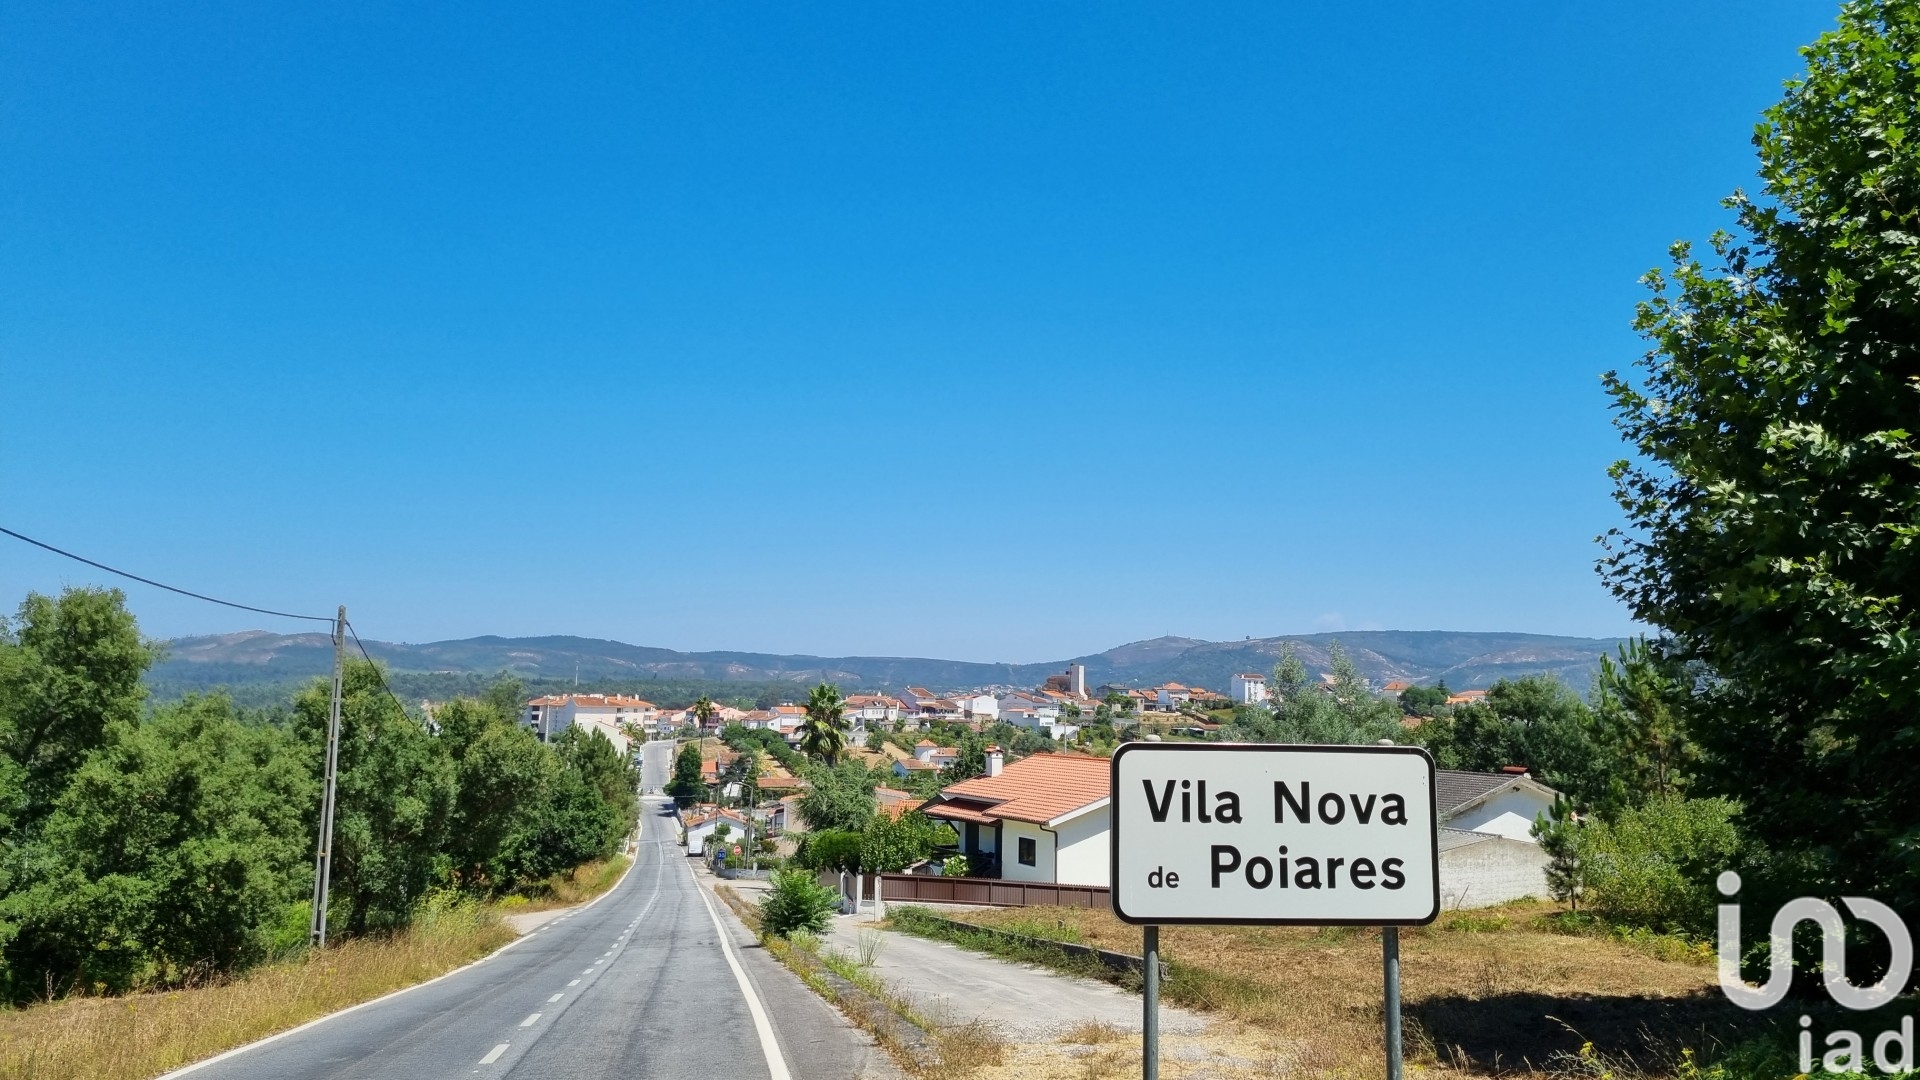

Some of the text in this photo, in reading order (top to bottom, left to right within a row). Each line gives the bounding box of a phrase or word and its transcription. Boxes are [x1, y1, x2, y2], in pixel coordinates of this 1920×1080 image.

[1142, 779, 1409, 826] Vila Nova
[1147, 844, 1406, 891] de Poiares
